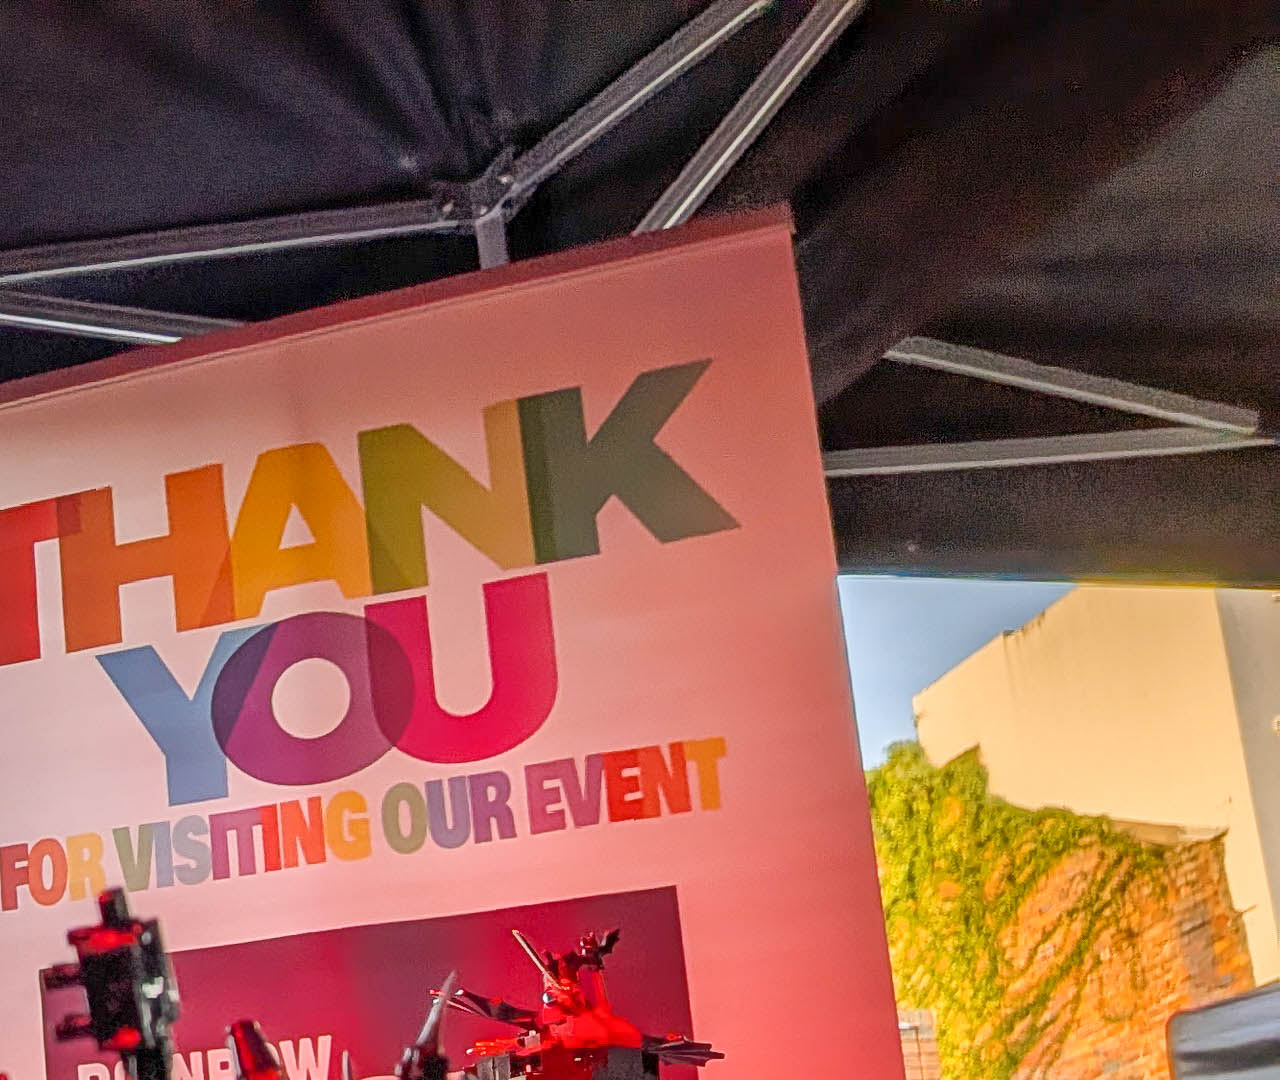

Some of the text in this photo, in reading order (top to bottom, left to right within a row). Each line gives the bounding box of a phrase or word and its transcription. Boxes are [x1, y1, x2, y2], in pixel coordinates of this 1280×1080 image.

[96, 573, 558, 805] YOU
[0, 737, 727, 911] FOR VISITING OUR EVENT
